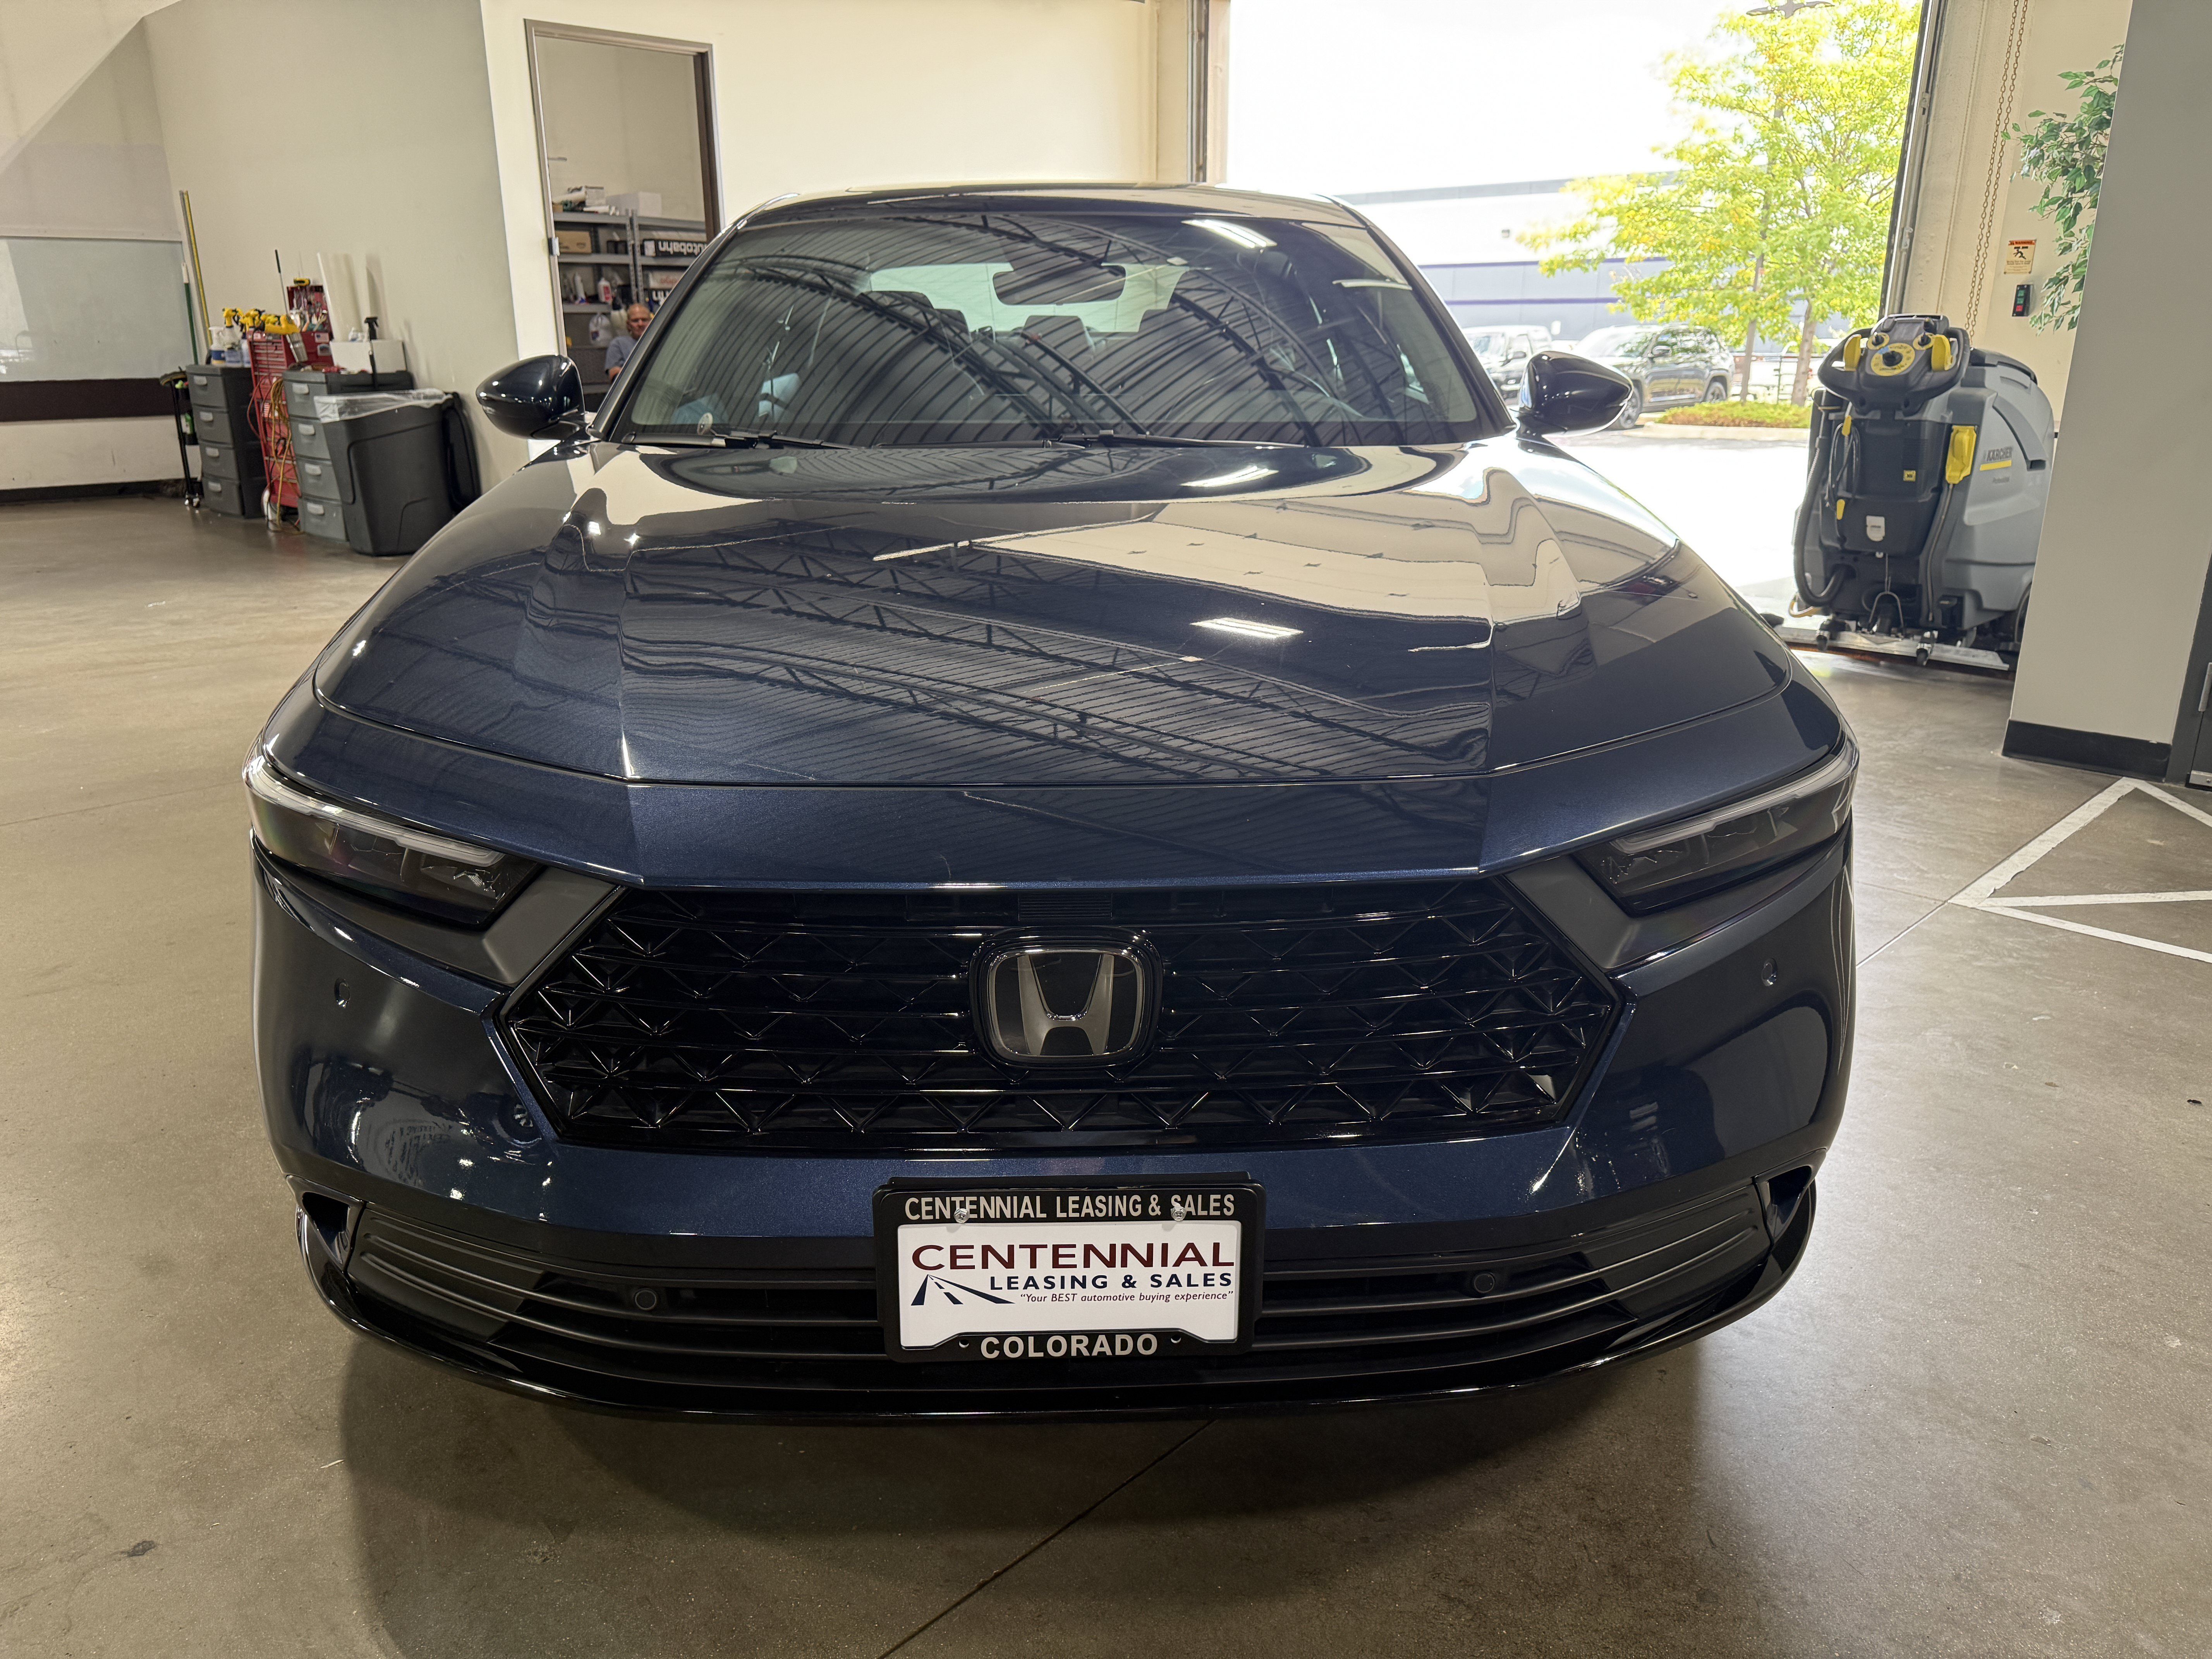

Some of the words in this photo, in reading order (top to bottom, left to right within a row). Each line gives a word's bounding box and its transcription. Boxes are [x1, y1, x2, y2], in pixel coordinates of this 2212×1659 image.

[659, 240, 708, 256] utobahn
[905, 1196, 1047, 1220] CENTENNIAL
[1056, 1195, 1142, 1218] LEASING
[1148, 1194, 1161, 1216] &
[912, 1242, 1234, 1270] CENTENNIAL
[990, 1275, 1107, 1290] LEASING
[1121, 1274, 1137, 1288] &
[1150, 1273, 1231, 1288] SALES
[1051, 1293, 1077, 1302] BEST
[1081, 1293, 1135, 1302] automotive
[1139, 1292, 1171, 1303] buying
[981, 1333, 1158, 1358] COLORADO
